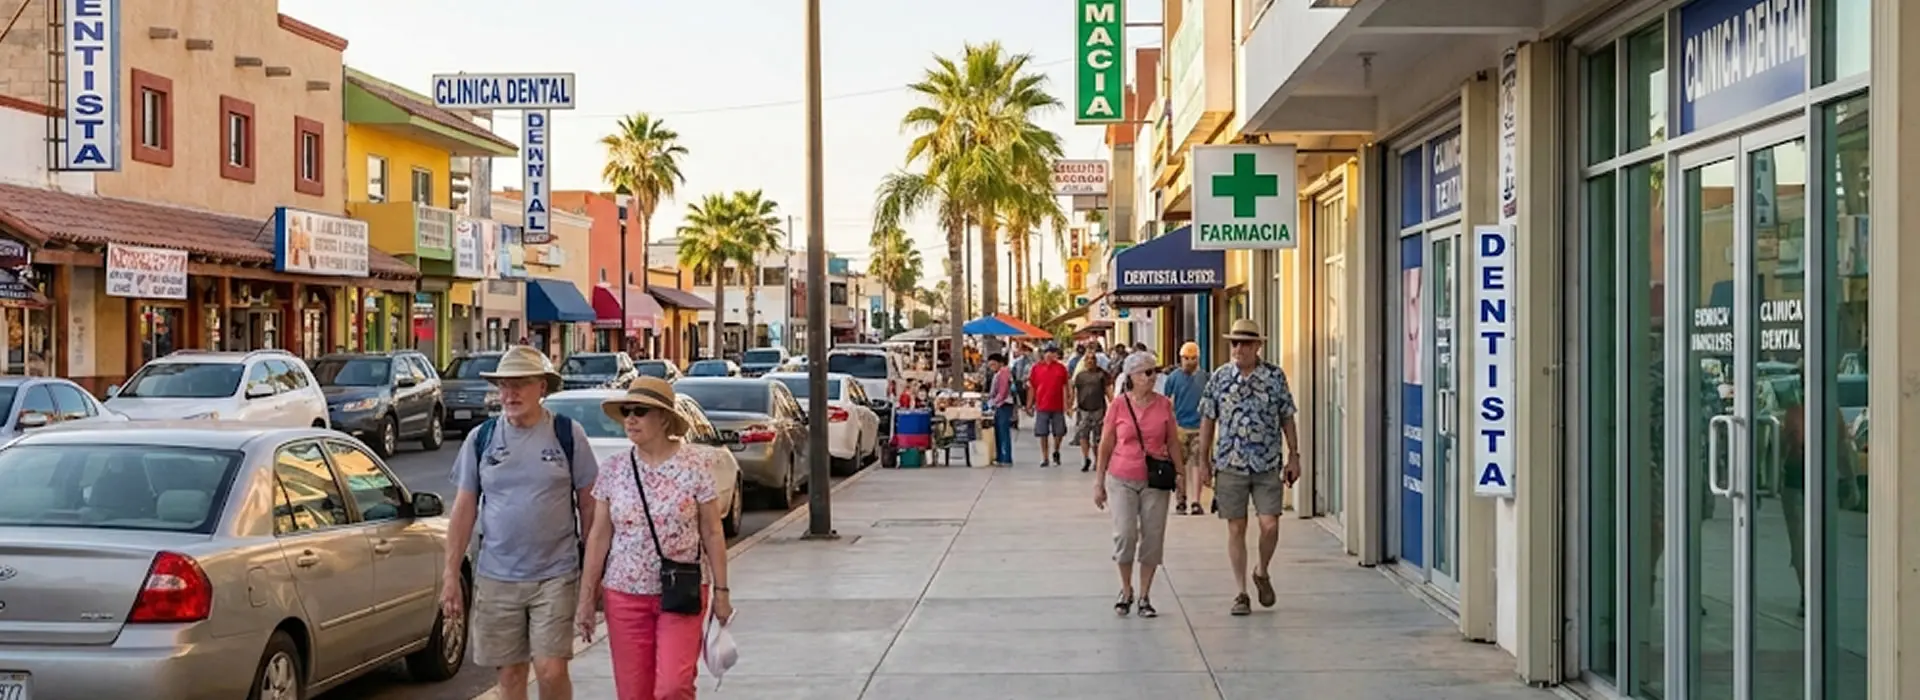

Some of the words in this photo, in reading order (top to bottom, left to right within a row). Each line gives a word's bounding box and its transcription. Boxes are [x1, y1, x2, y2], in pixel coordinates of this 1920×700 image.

[1085, 3, 1115, 116] MACIA
[1685, 15, 1741, 103] CLINICA
[1745, 0, 1808, 78] DENTAL
[436, 78, 501, 104] CLINICA
[507, 78, 570, 103] DENTAL
[1200, 223, 1290, 241] FARMACIA
[1124, 269, 1178, 285] DENTISTA
[1760, 299, 1803, 322] CLINICA
[1761, 328, 1802, 350] DENTAL
[1480, 233, 1506, 486] DENTISTA
